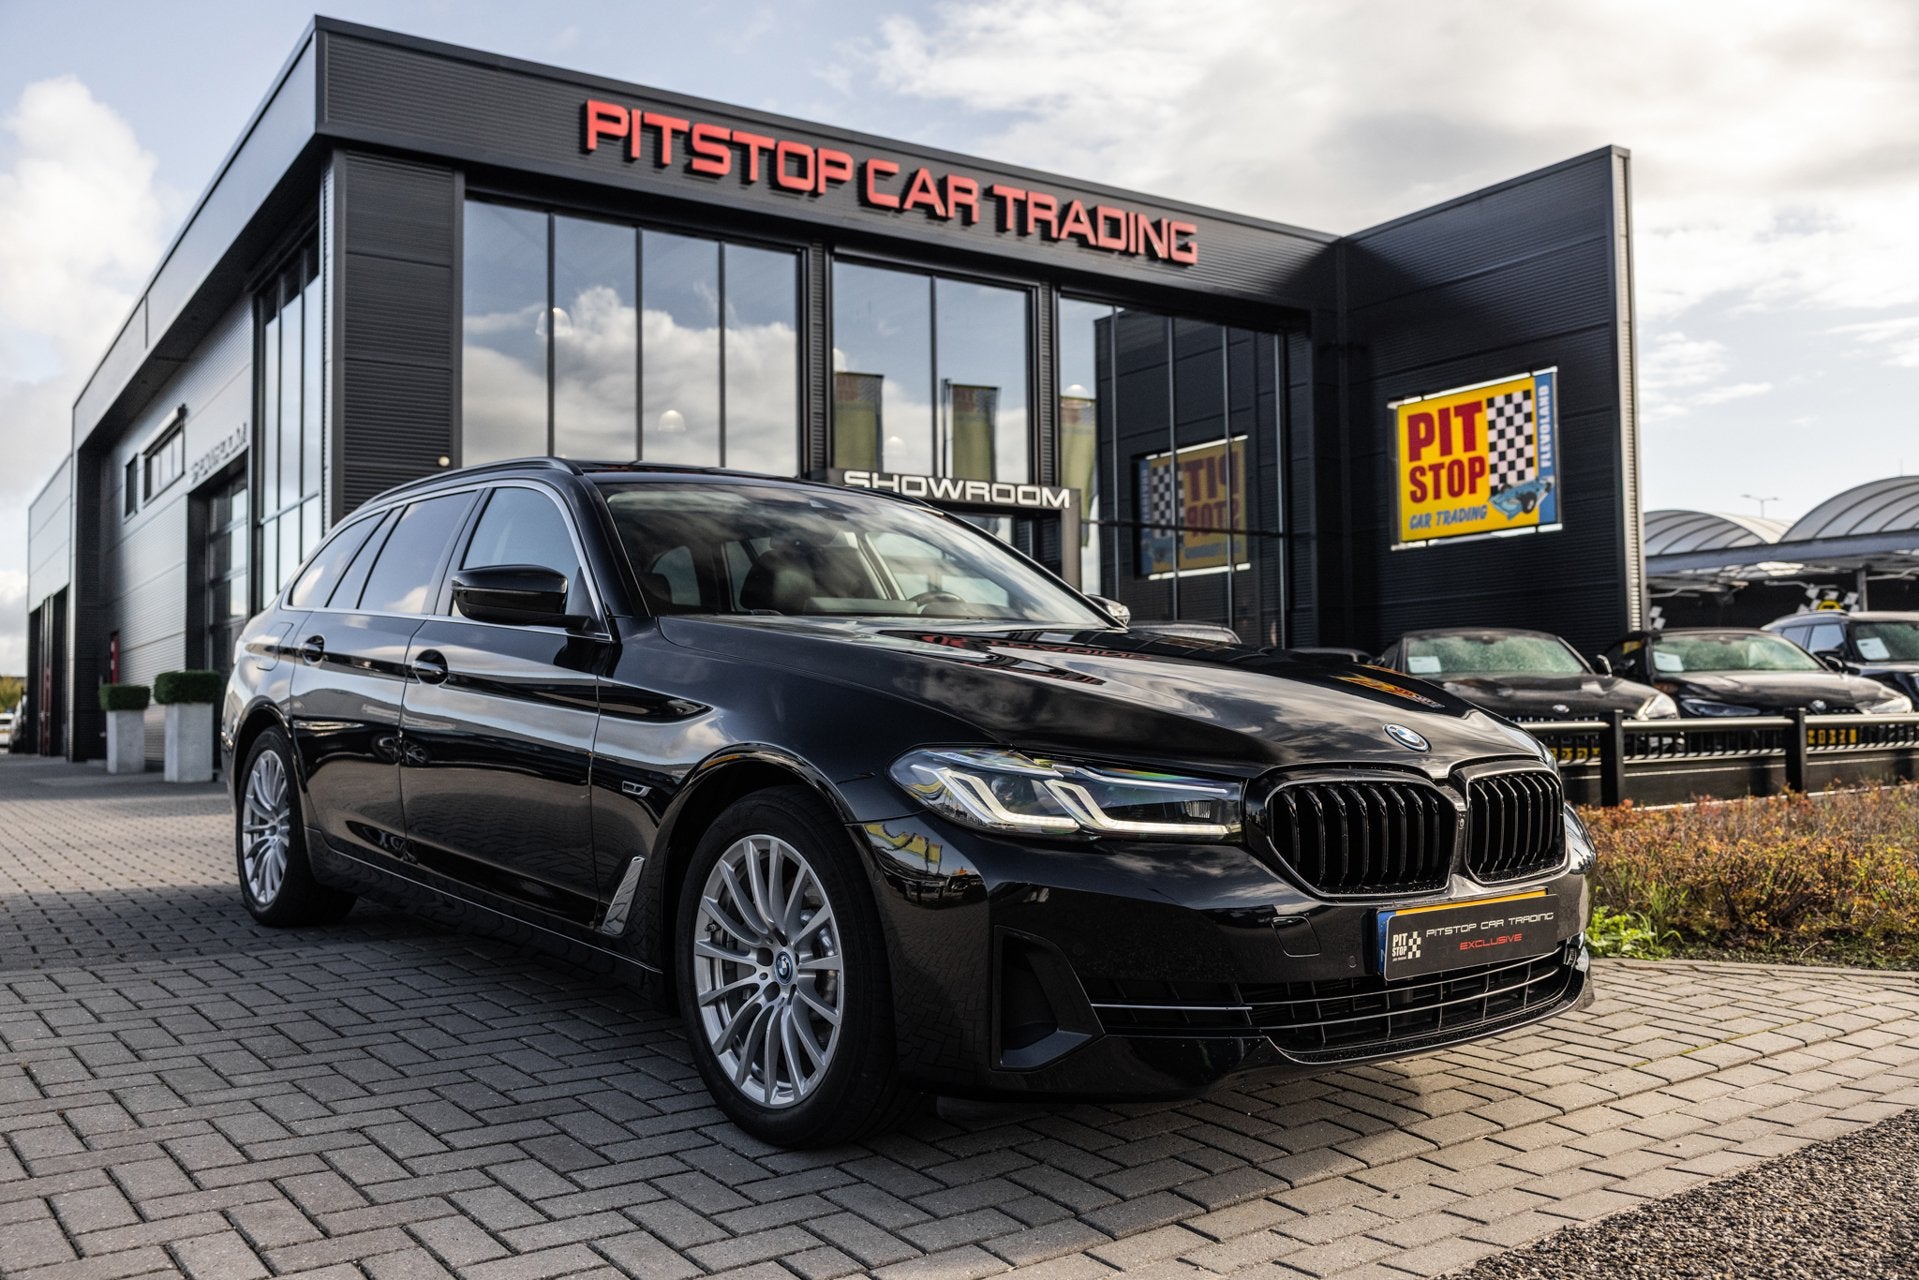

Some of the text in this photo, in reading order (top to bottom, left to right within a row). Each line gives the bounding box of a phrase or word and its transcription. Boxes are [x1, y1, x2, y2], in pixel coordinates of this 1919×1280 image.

[588, 100, 1196, 262] PITSTOP CAR TRADING
[1407, 400, 1483, 463] PIT
[1538, 385, 1552, 467] FLEVOLAND
[844, 470, 1070, 508] SHOWROOM
[1409, 456, 1486, 503] STOP
[1409, 504, 1488, 530] CAR TRADING
[1392, 932, 1408, 947] PIT
[1426, 912, 1554, 937] PITSTOP CAR TRADING
[1391, 945, 1408, 957] STOP
[1459, 933, 1523, 950] EXCLUSIVE
